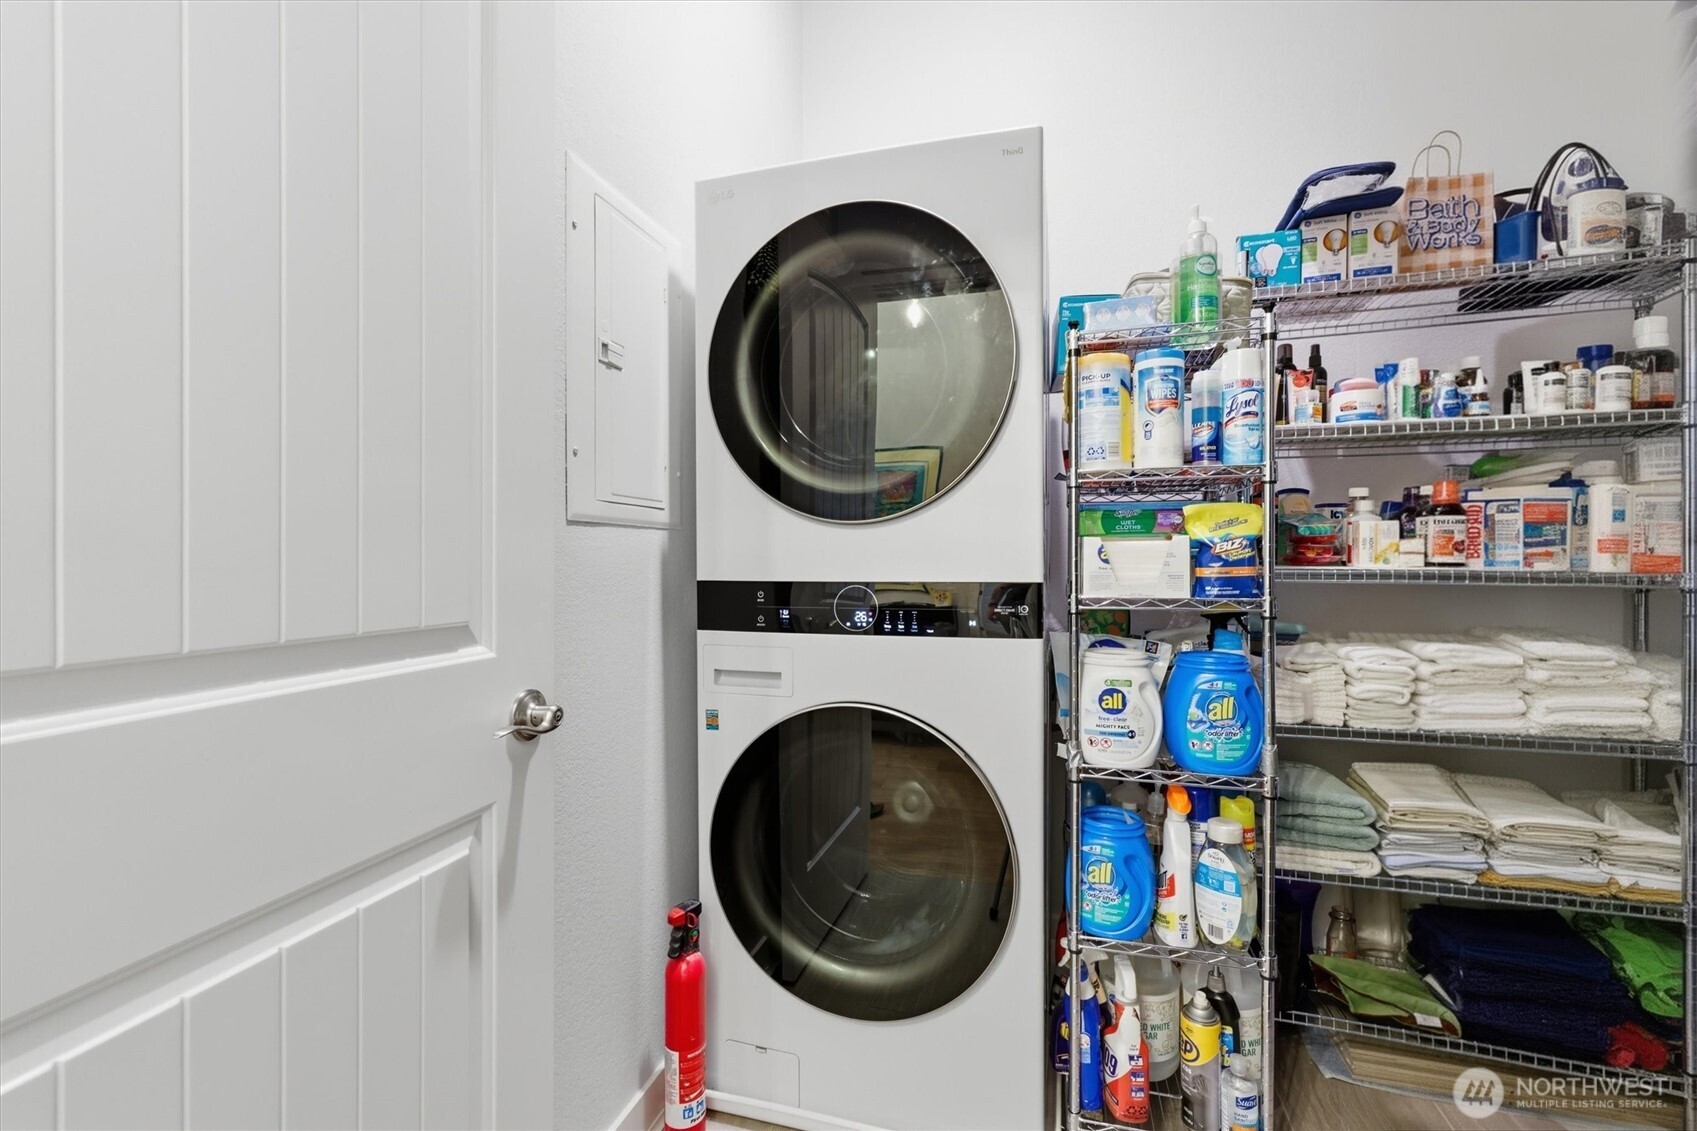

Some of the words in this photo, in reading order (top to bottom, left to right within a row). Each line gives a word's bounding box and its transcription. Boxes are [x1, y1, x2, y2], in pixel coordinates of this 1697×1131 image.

[1407, 195, 1481, 221] Bath
[1151, 388, 1177, 398] WIPES
[1225, 393, 1259, 418] Lysol
[1214, 537, 1244, 553] BIZ
[1101, 693, 1123, 709] all
[1208, 696, 1234, 720] all
[1225, 730, 1241, 738] lifter
[1087, 862, 1112, 883] all
[1087, 892, 1102, 900] odor
[1102, 893, 1117, 903] lifter
[1150, 1021, 1170, 1032] WHITE
